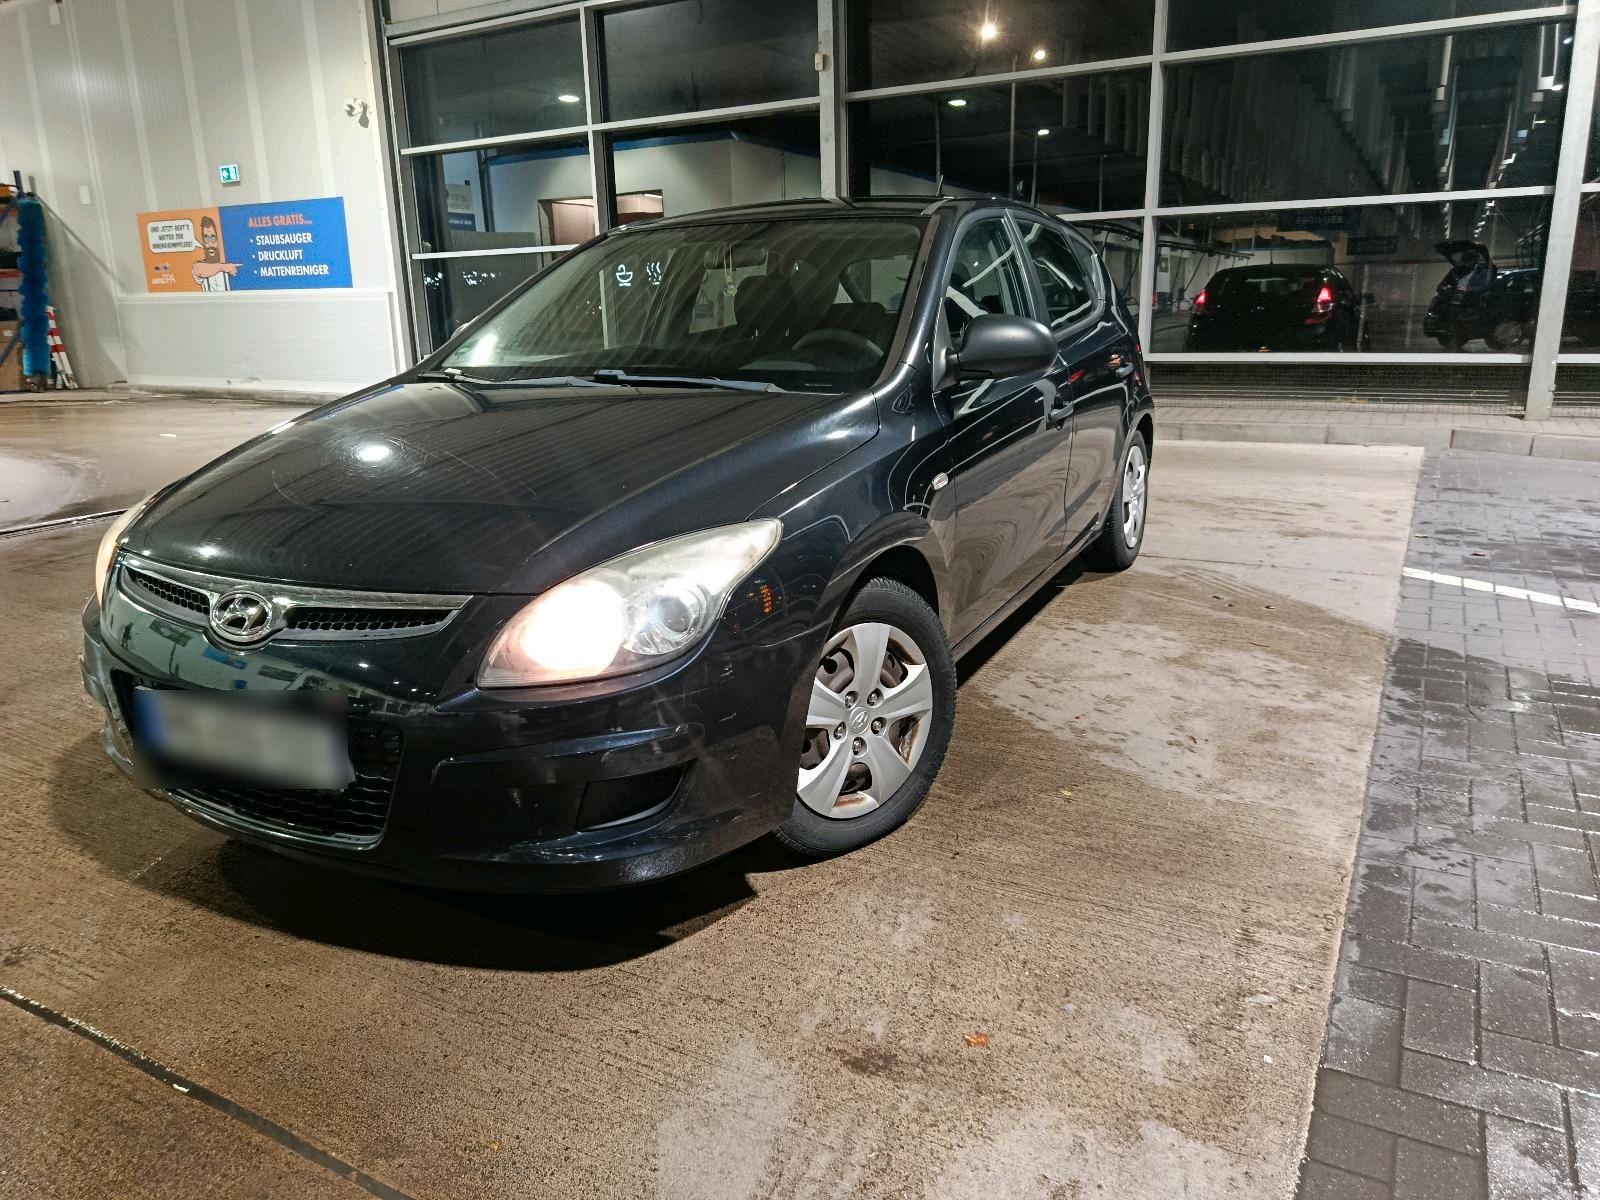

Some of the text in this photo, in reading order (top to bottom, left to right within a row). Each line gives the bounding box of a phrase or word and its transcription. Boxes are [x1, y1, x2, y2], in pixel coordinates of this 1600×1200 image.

[248, 213, 313, 228] ALLES GRATIS...
[255, 232, 313, 246] STAUBSAUGER
[257, 249, 303, 262] DRUCKLUFT
[260, 264, 330, 277] MATTENREINIGER
